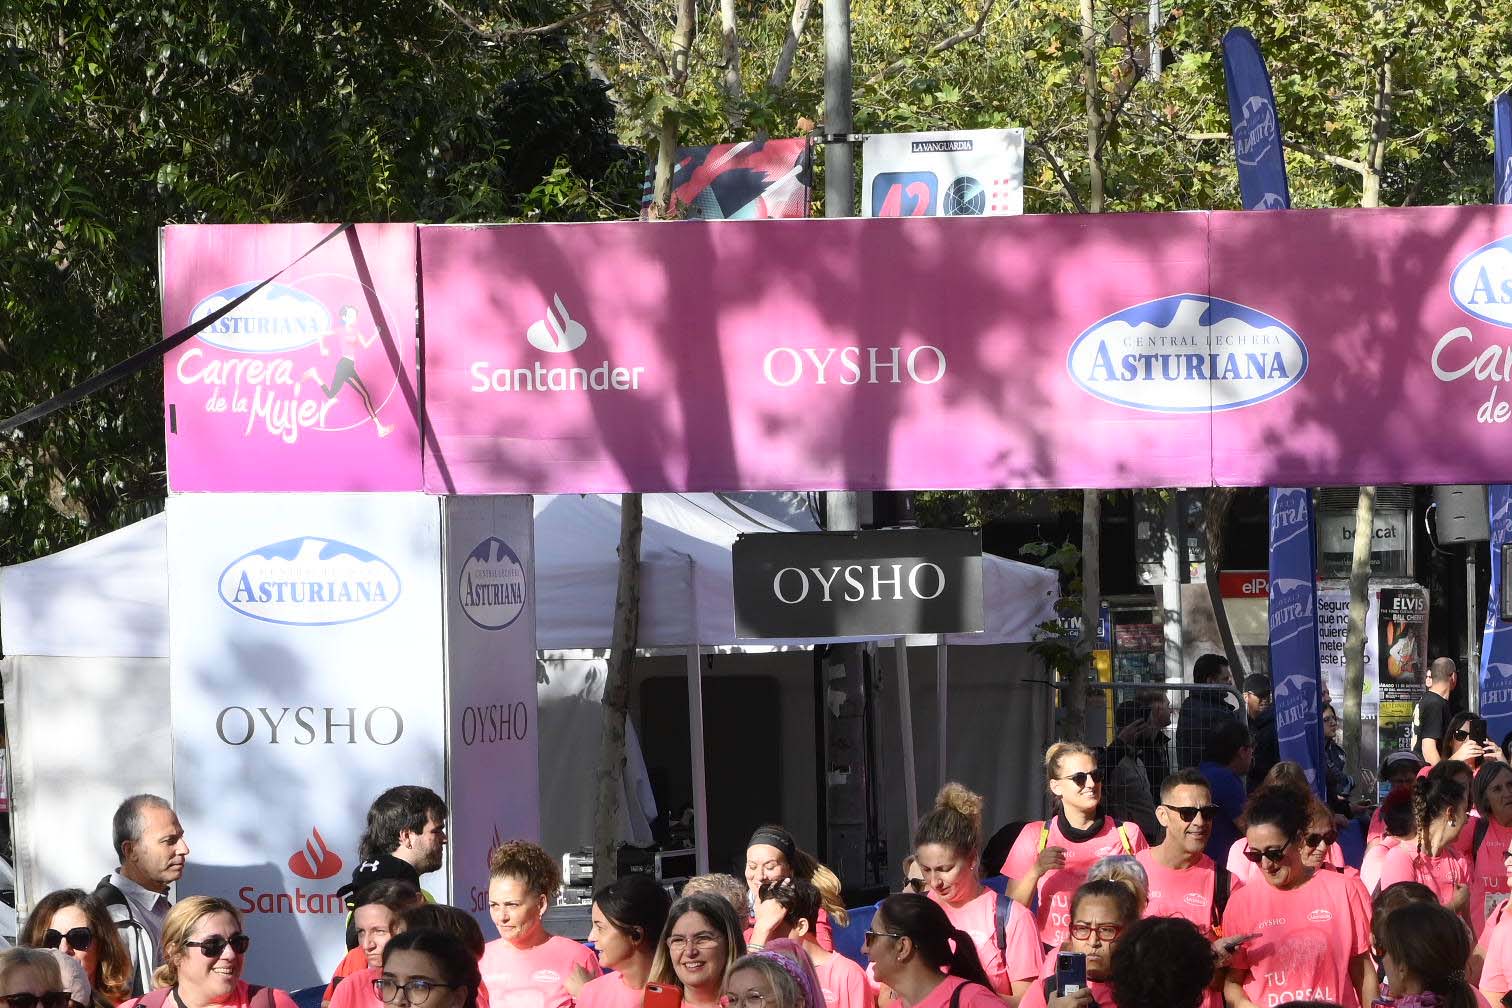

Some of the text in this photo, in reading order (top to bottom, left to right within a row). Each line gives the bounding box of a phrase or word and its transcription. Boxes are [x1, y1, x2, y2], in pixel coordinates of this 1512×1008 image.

[1123, 335, 1281, 346] CENTRAL LECHERA
[176, 348, 294, 385] Carrera
[470, 360, 645, 393] Santander
[763, 345, 947, 386] OYSHO
[1087, 341, 1289, 383] ASTURIANA
[205, 383, 338, 444] de la Mujer
[1476, 385, 1511, 424] de
[233, 569, 388, 603] ASTURIANA
[465, 571, 522, 607] ASTURIANA
[773, 562, 946, 604] OYSHO
[1393, 598, 1423, 610] ELVIS
[1319, 615, 1337, 628] que
[1320, 656, 1338, 664] este
[215, 706, 404, 746] OYSHO
[462, 701, 527, 746] OYSHO
[1481, 876, 1498, 887] TU
[239, 886, 343, 913] Santan
[1264, 970, 1286, 987] TU
[1268, 986, 1332, 1008] DORSAL
